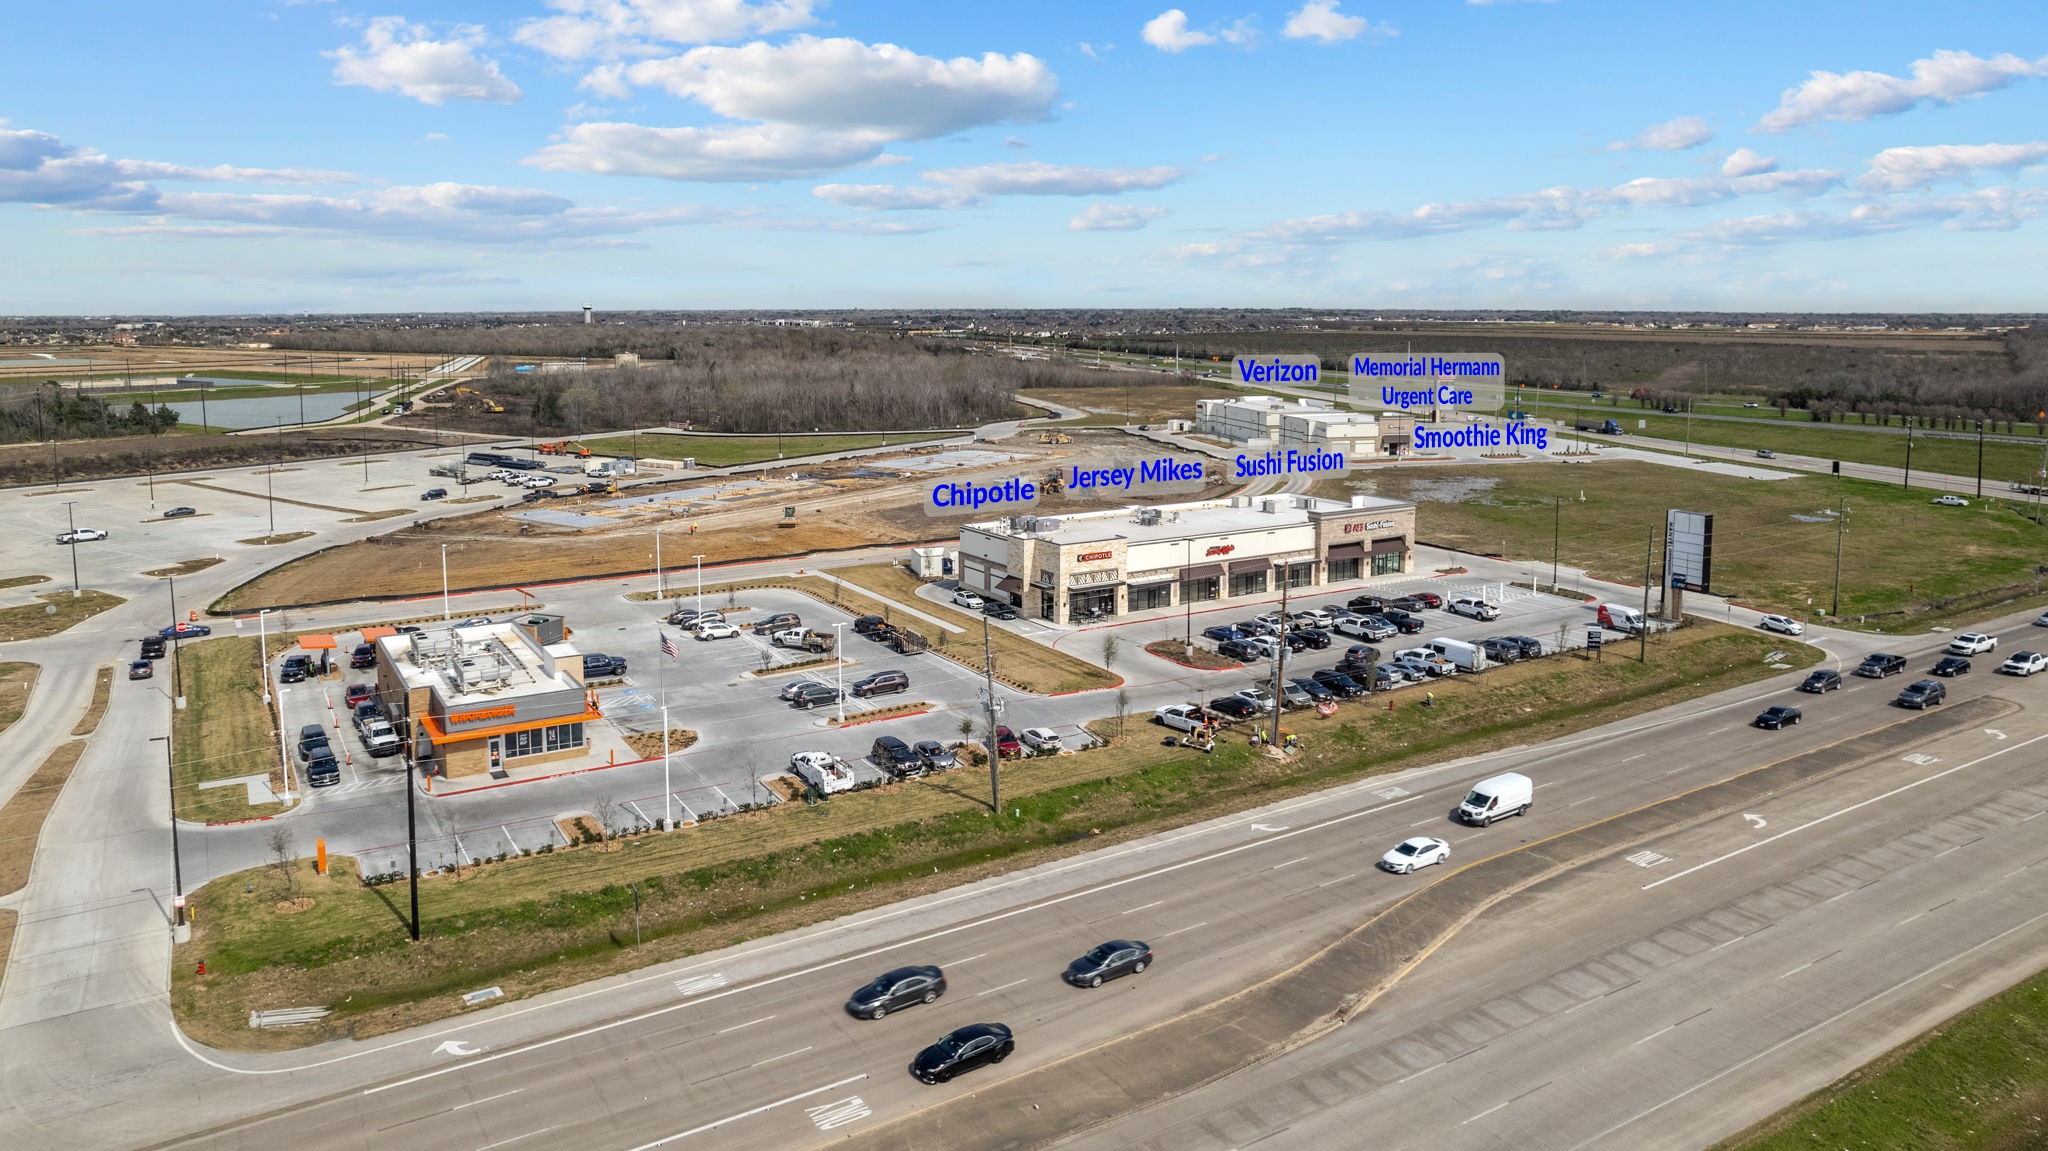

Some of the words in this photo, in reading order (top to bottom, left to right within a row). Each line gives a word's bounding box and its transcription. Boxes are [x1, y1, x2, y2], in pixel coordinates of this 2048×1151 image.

[1085, 552, 1111, 560] CHIPOTLE
[1625, 850, 1674, 869] ONLY
[804, 1095, 873, 1131] ONLY
